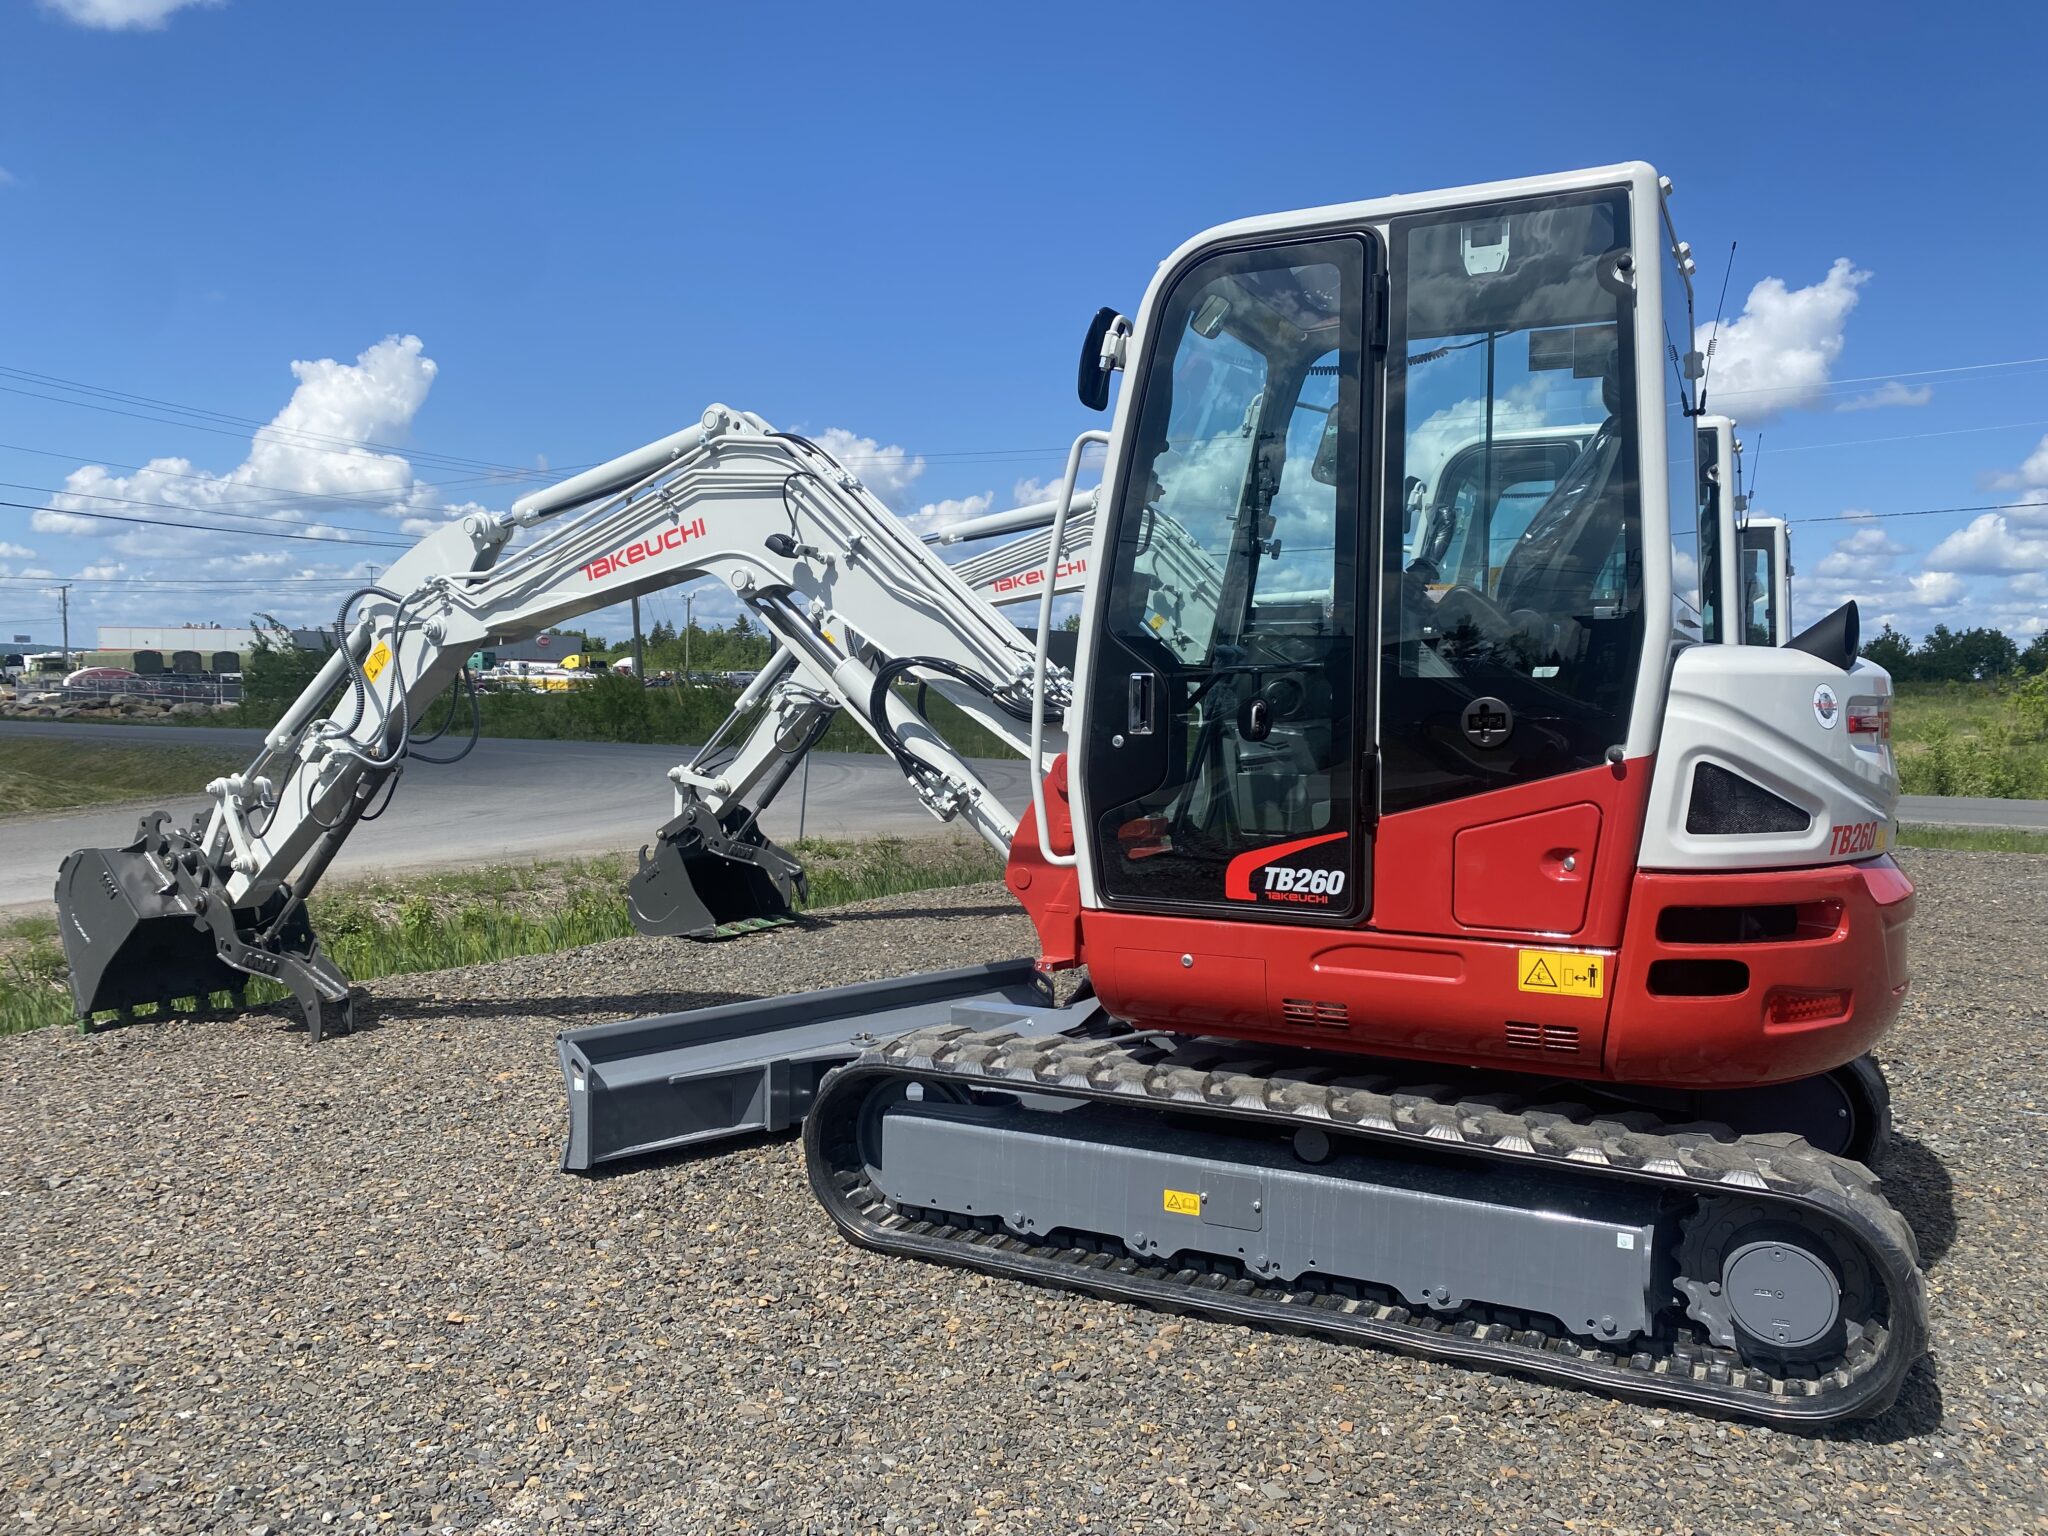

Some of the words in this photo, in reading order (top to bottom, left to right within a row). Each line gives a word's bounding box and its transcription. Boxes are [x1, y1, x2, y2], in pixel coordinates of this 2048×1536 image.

[579, 517, 706, 581] TAKEUCHI
[1829, 821, 1878, 856] TB260
[1264, 866, 1346, 895] TB260
[1264, 891, 1329, 904] TAKEUCHI
